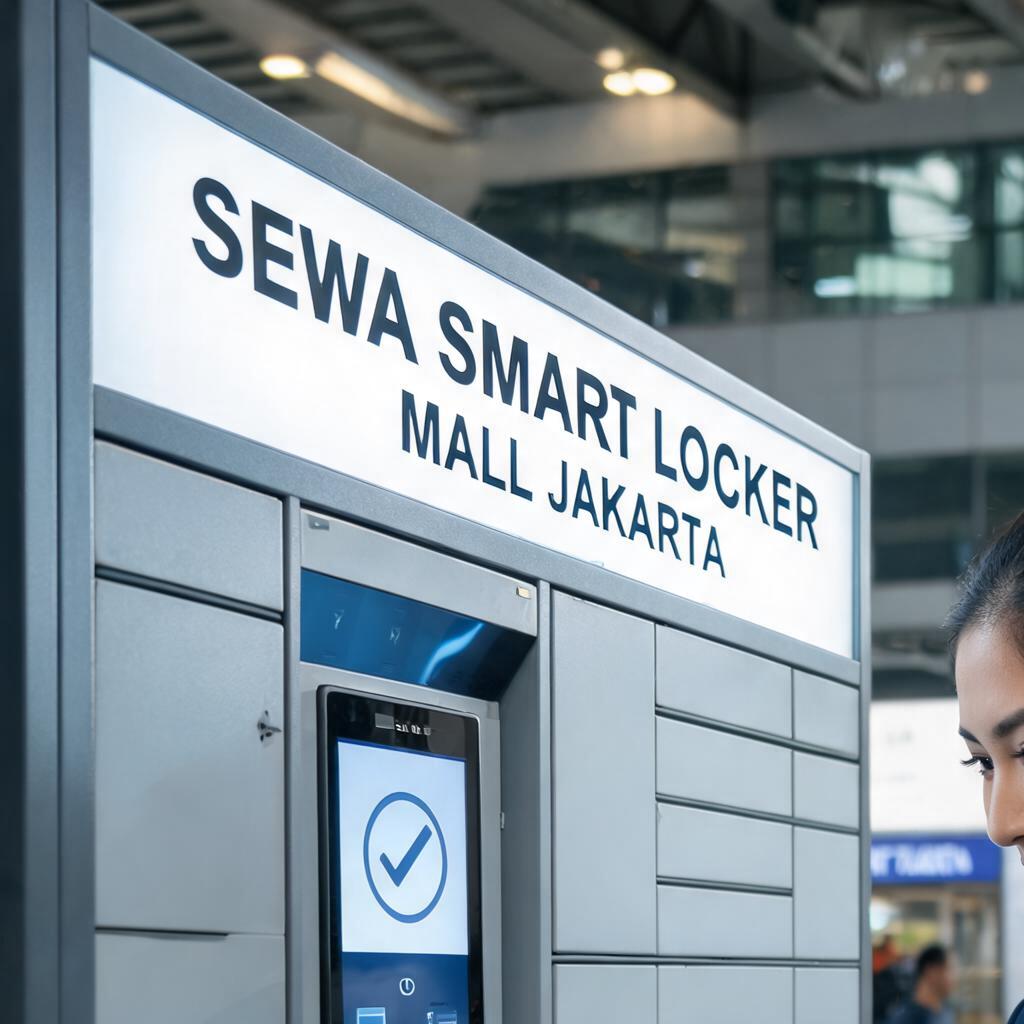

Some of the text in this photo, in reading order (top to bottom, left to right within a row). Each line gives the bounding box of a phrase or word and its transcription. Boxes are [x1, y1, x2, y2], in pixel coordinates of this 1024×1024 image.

[191, 177, 819, 550] SEWA SMART LOCKER
[401, 389, 726, 578] MALL JAKARTA
